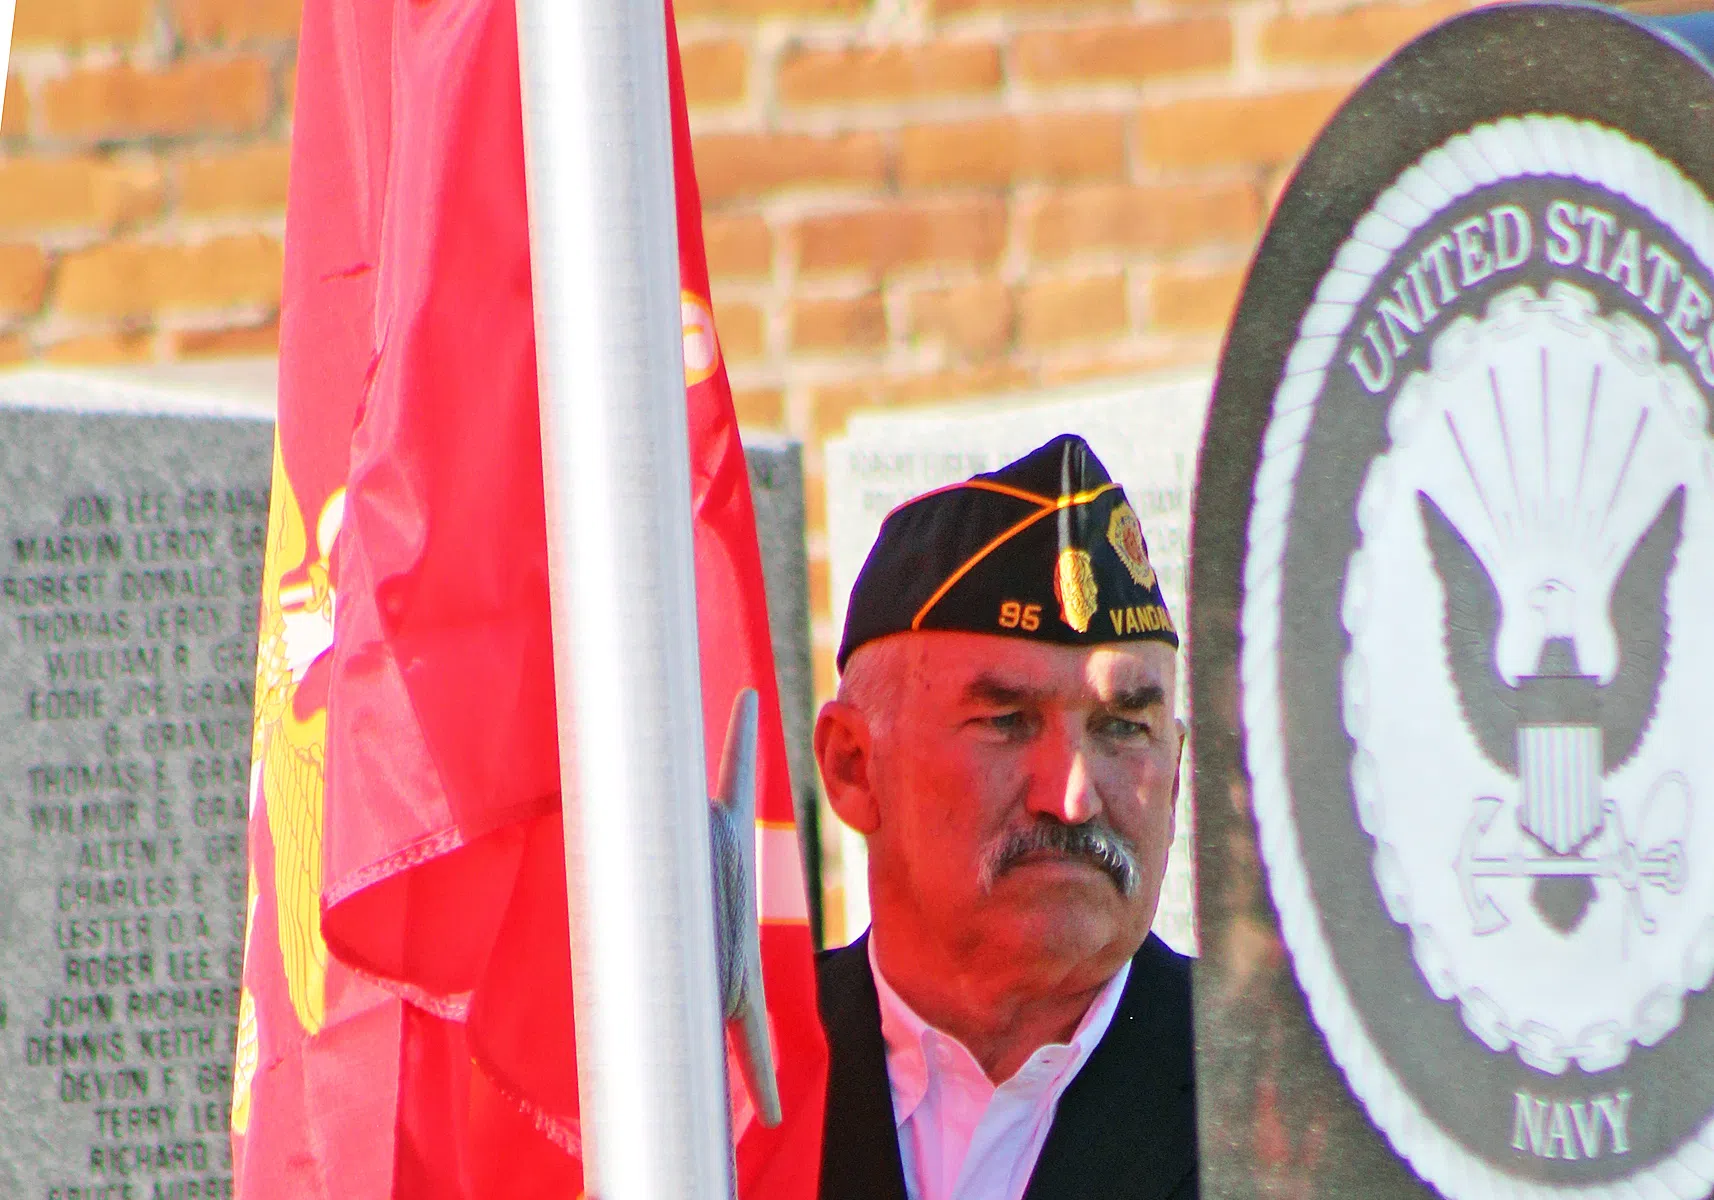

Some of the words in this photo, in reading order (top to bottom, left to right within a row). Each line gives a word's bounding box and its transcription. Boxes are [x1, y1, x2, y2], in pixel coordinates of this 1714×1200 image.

[1349, 205, 1533, 393] UNITED
[60, 494, 113, 528] JON
[16, 533, 121, 566] MARVIN
[135, 529, 215, 562] LEROY
[3, 573, 107, 607] ROBERT
[120, 564, 228, 602] DONALD
[17, 609, 130, 643] THOMAS
[145, 605, 223, 638] LEROY
[999, 600, 1043, 632] 95
[45, 647, 160, 680] WILLIAM
[28, 762, 142, 797] THOMAS
[56, 874, 179, 912] CHARLES
[55, 914, 153, 950] LESTER
[66, 949, 154, 987] ROGER
[168, 949, 212, 981] LEE
[43, 992, 113, 1028] JOHN
[25, 1031, 126, 1067] DENNIS
[138, 1024, 214, 1061] KEITH
[59, 1067, 149, 1103] DEVON
[93, 1102, 177, 1140] TERRY
[1510, 1090, 1633, 1160] NAVY
[88, 1140, 207, 1178] RICHARD
